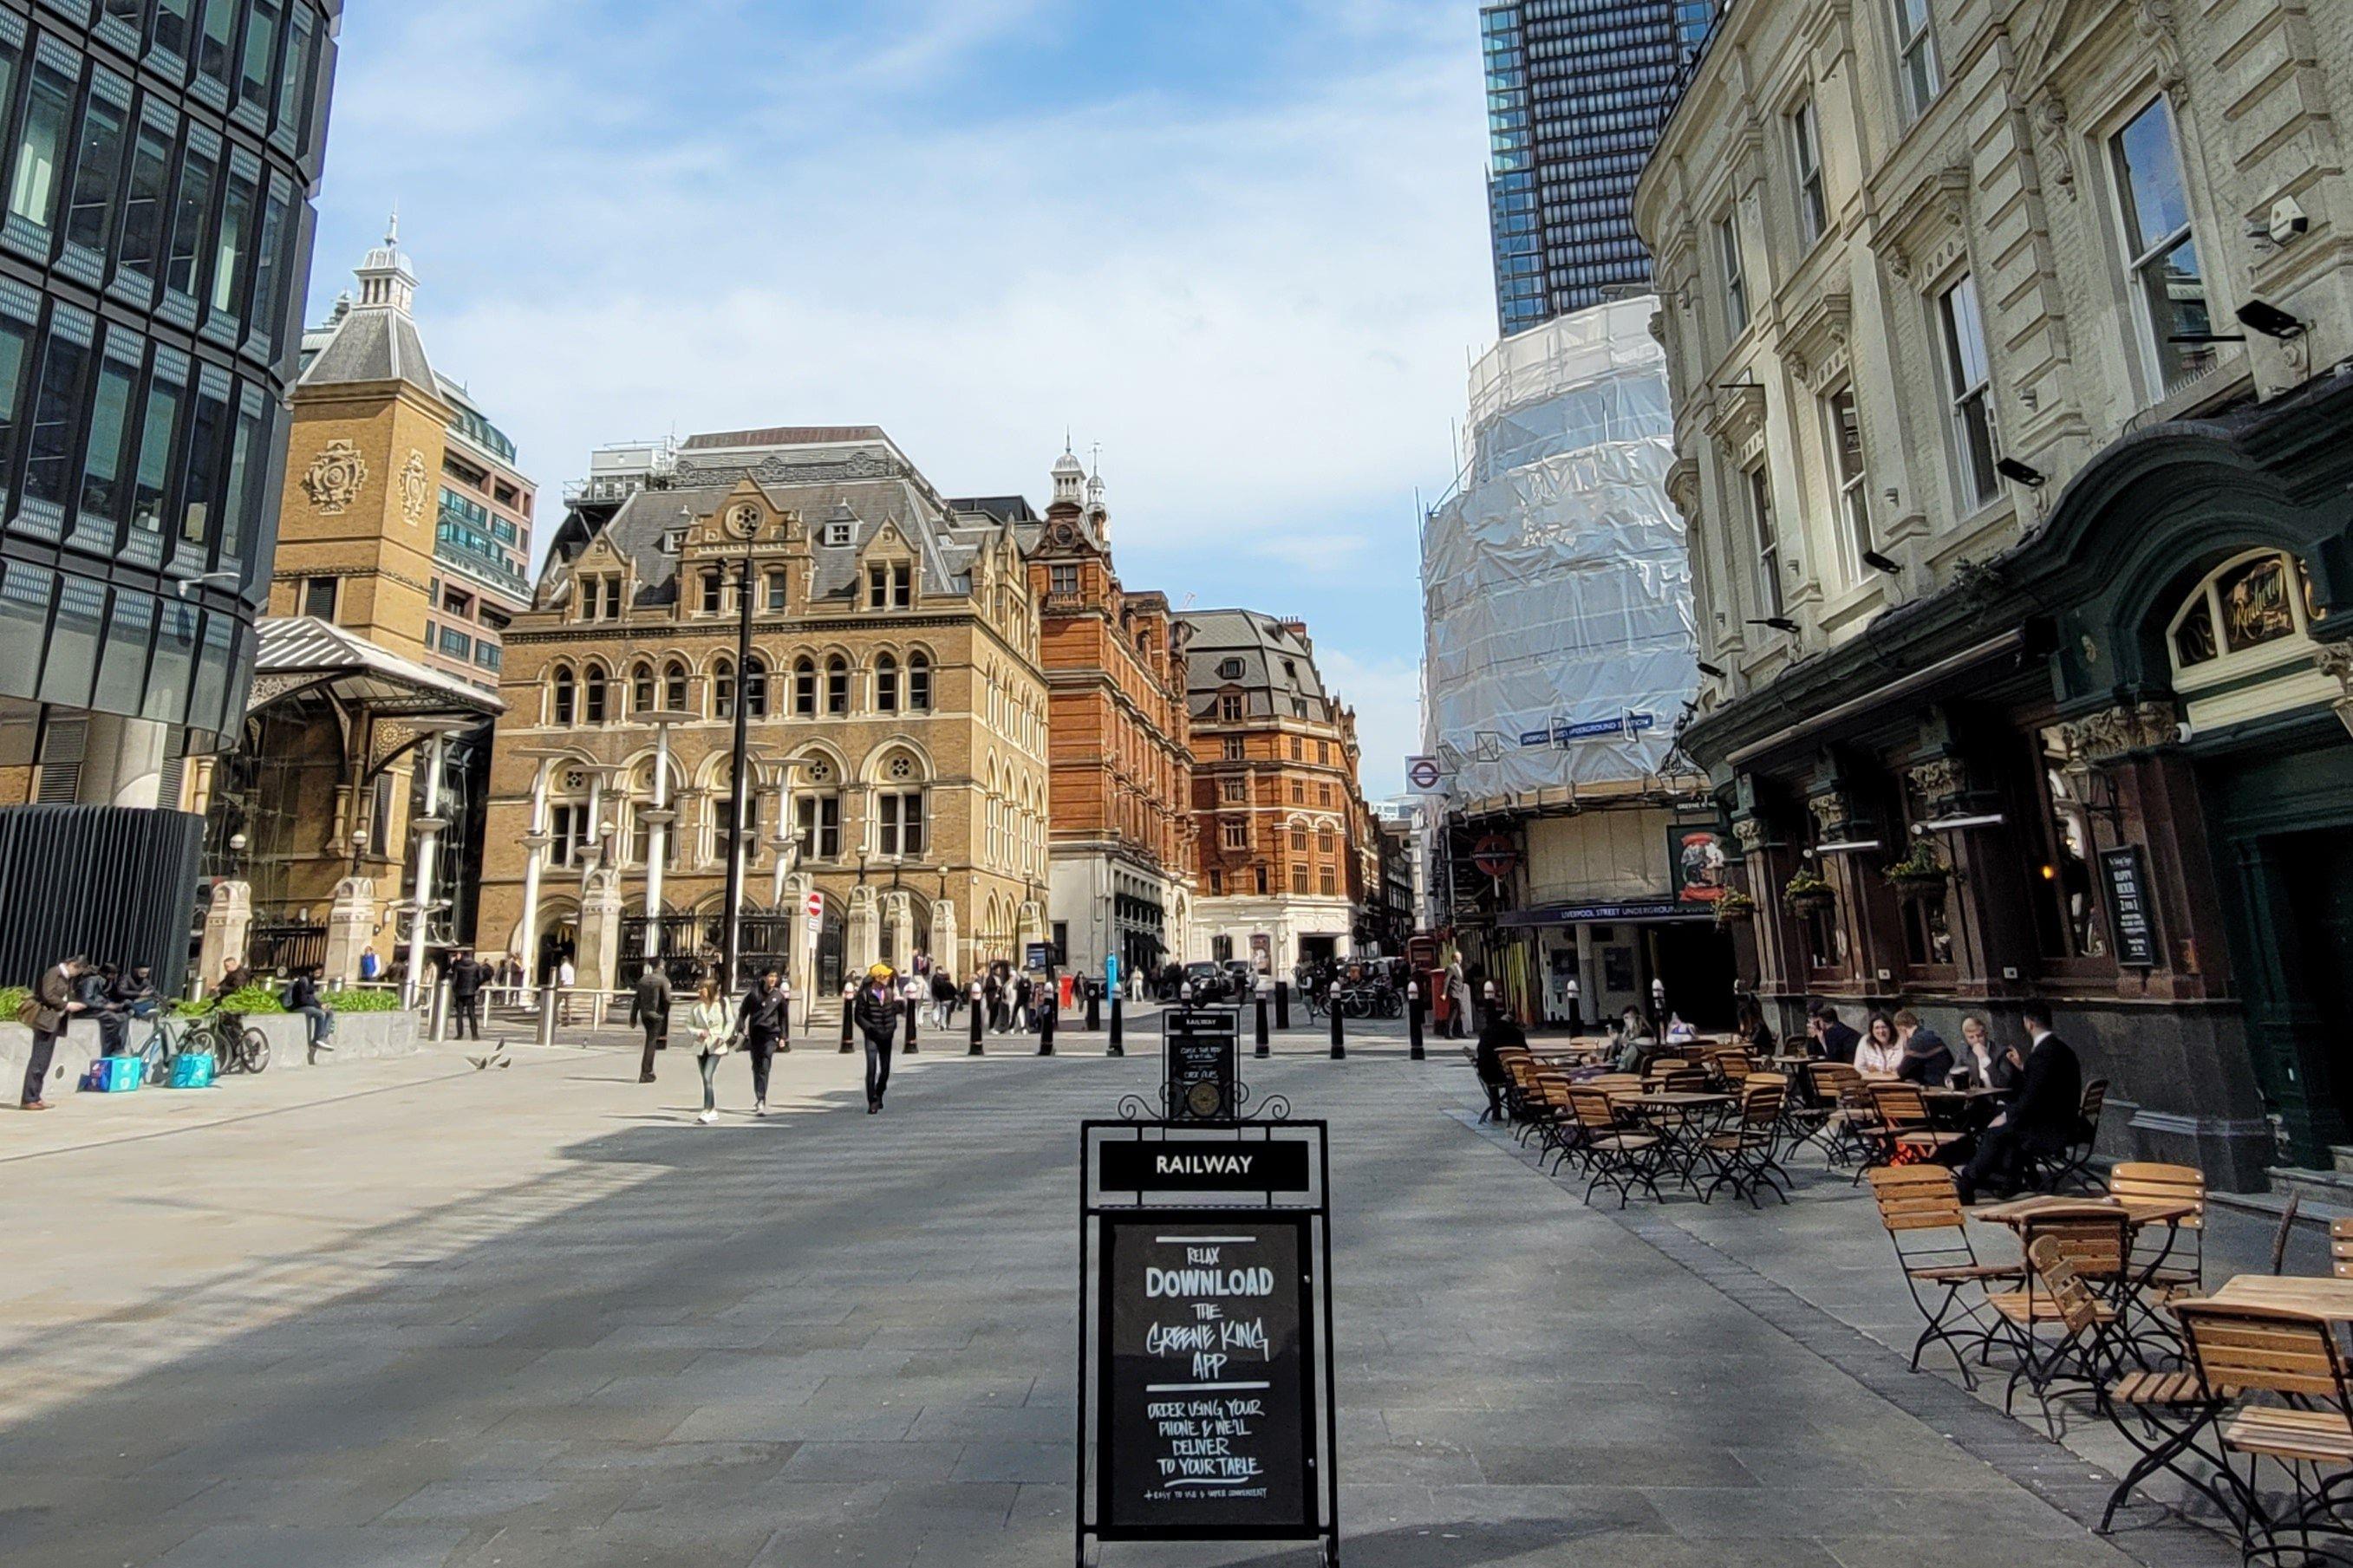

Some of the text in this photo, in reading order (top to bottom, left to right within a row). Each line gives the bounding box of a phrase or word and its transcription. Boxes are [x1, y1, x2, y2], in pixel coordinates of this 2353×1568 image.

[1561, 908, 1594, 919] LIVERPOOL
[1596, 908, 1621, 917] STREET
[1157, 1155, 1253, 1174] RAILWAY
[1187, 1246, 1220, 1265] RELAX
[1145, 1266, 1274, 1298] DOWNLOAD
[1190, 1303, 1223, 1320] THE
[1146, 1317, 1269, 1362] GREENE KING
[1192, 1350, 1228, 1381] APP
[1147, 1398, 1266, 1420] ORDER USING YOUR
[1158, 1420, 1200, 1437] PHONE
[1172, 1437, 1230, 1456] DELIVER
[1157, 1457, 1264, 1476] TO YOUR TABLE
